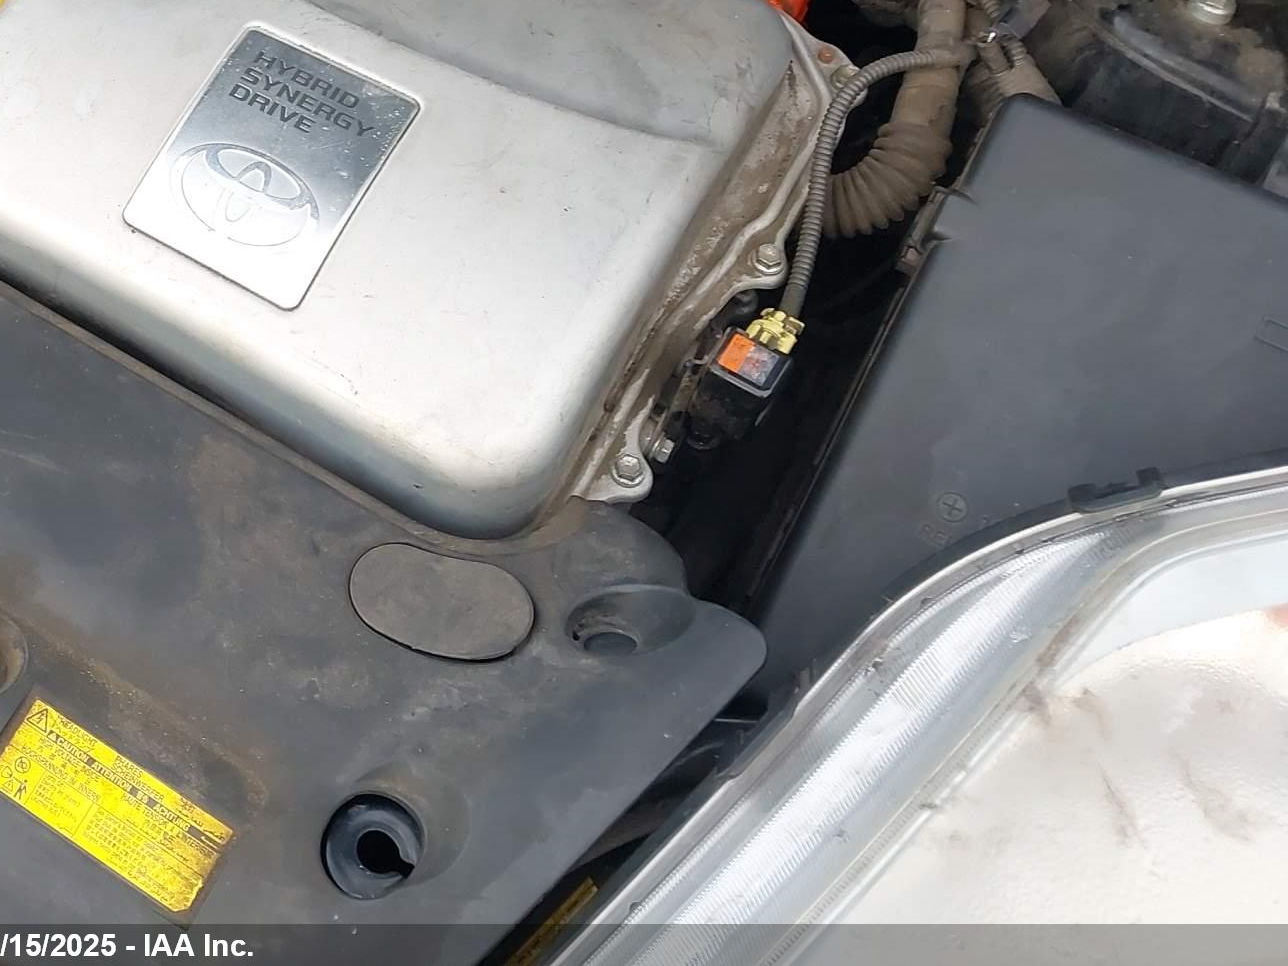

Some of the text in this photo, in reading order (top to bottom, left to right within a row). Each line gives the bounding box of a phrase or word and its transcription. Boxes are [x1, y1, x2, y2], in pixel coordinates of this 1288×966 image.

[229, 83, 316, 133] DRIVE
[240, 66, 375, 136] SYNERGY
[253, 51, 360, 109] HYBRID
[56, 736, 90, 763] CAUTION
[91, 760, 132, 792] ATTENTION
[152, 802, 191, 832] ACHTUNG
